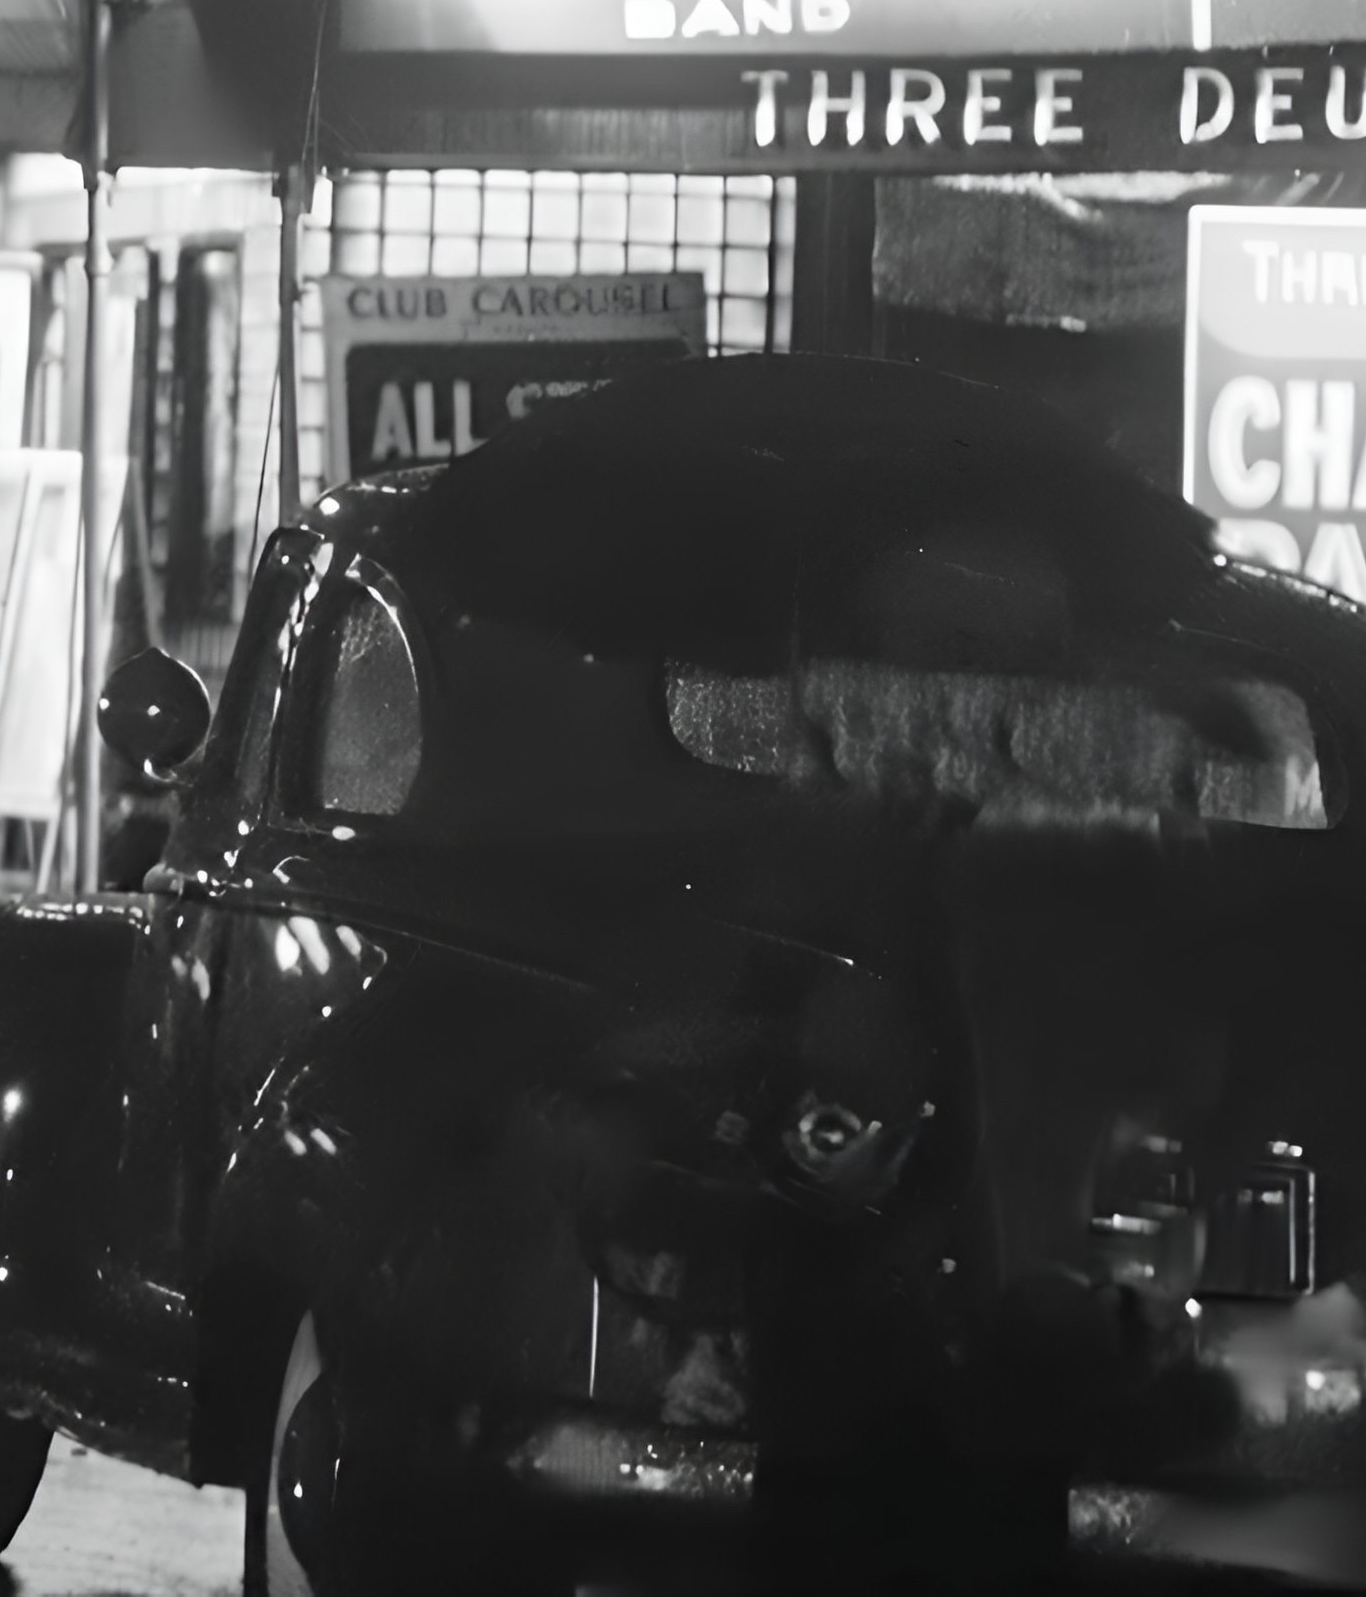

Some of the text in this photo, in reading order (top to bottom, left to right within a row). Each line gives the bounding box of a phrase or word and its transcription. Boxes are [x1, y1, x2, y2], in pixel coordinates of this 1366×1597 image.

[741, 65, 1086, 147] THREE
[346, 283, 679, 321] CLUB CAROUSEL
[371, 379, 490, 462] ALL
